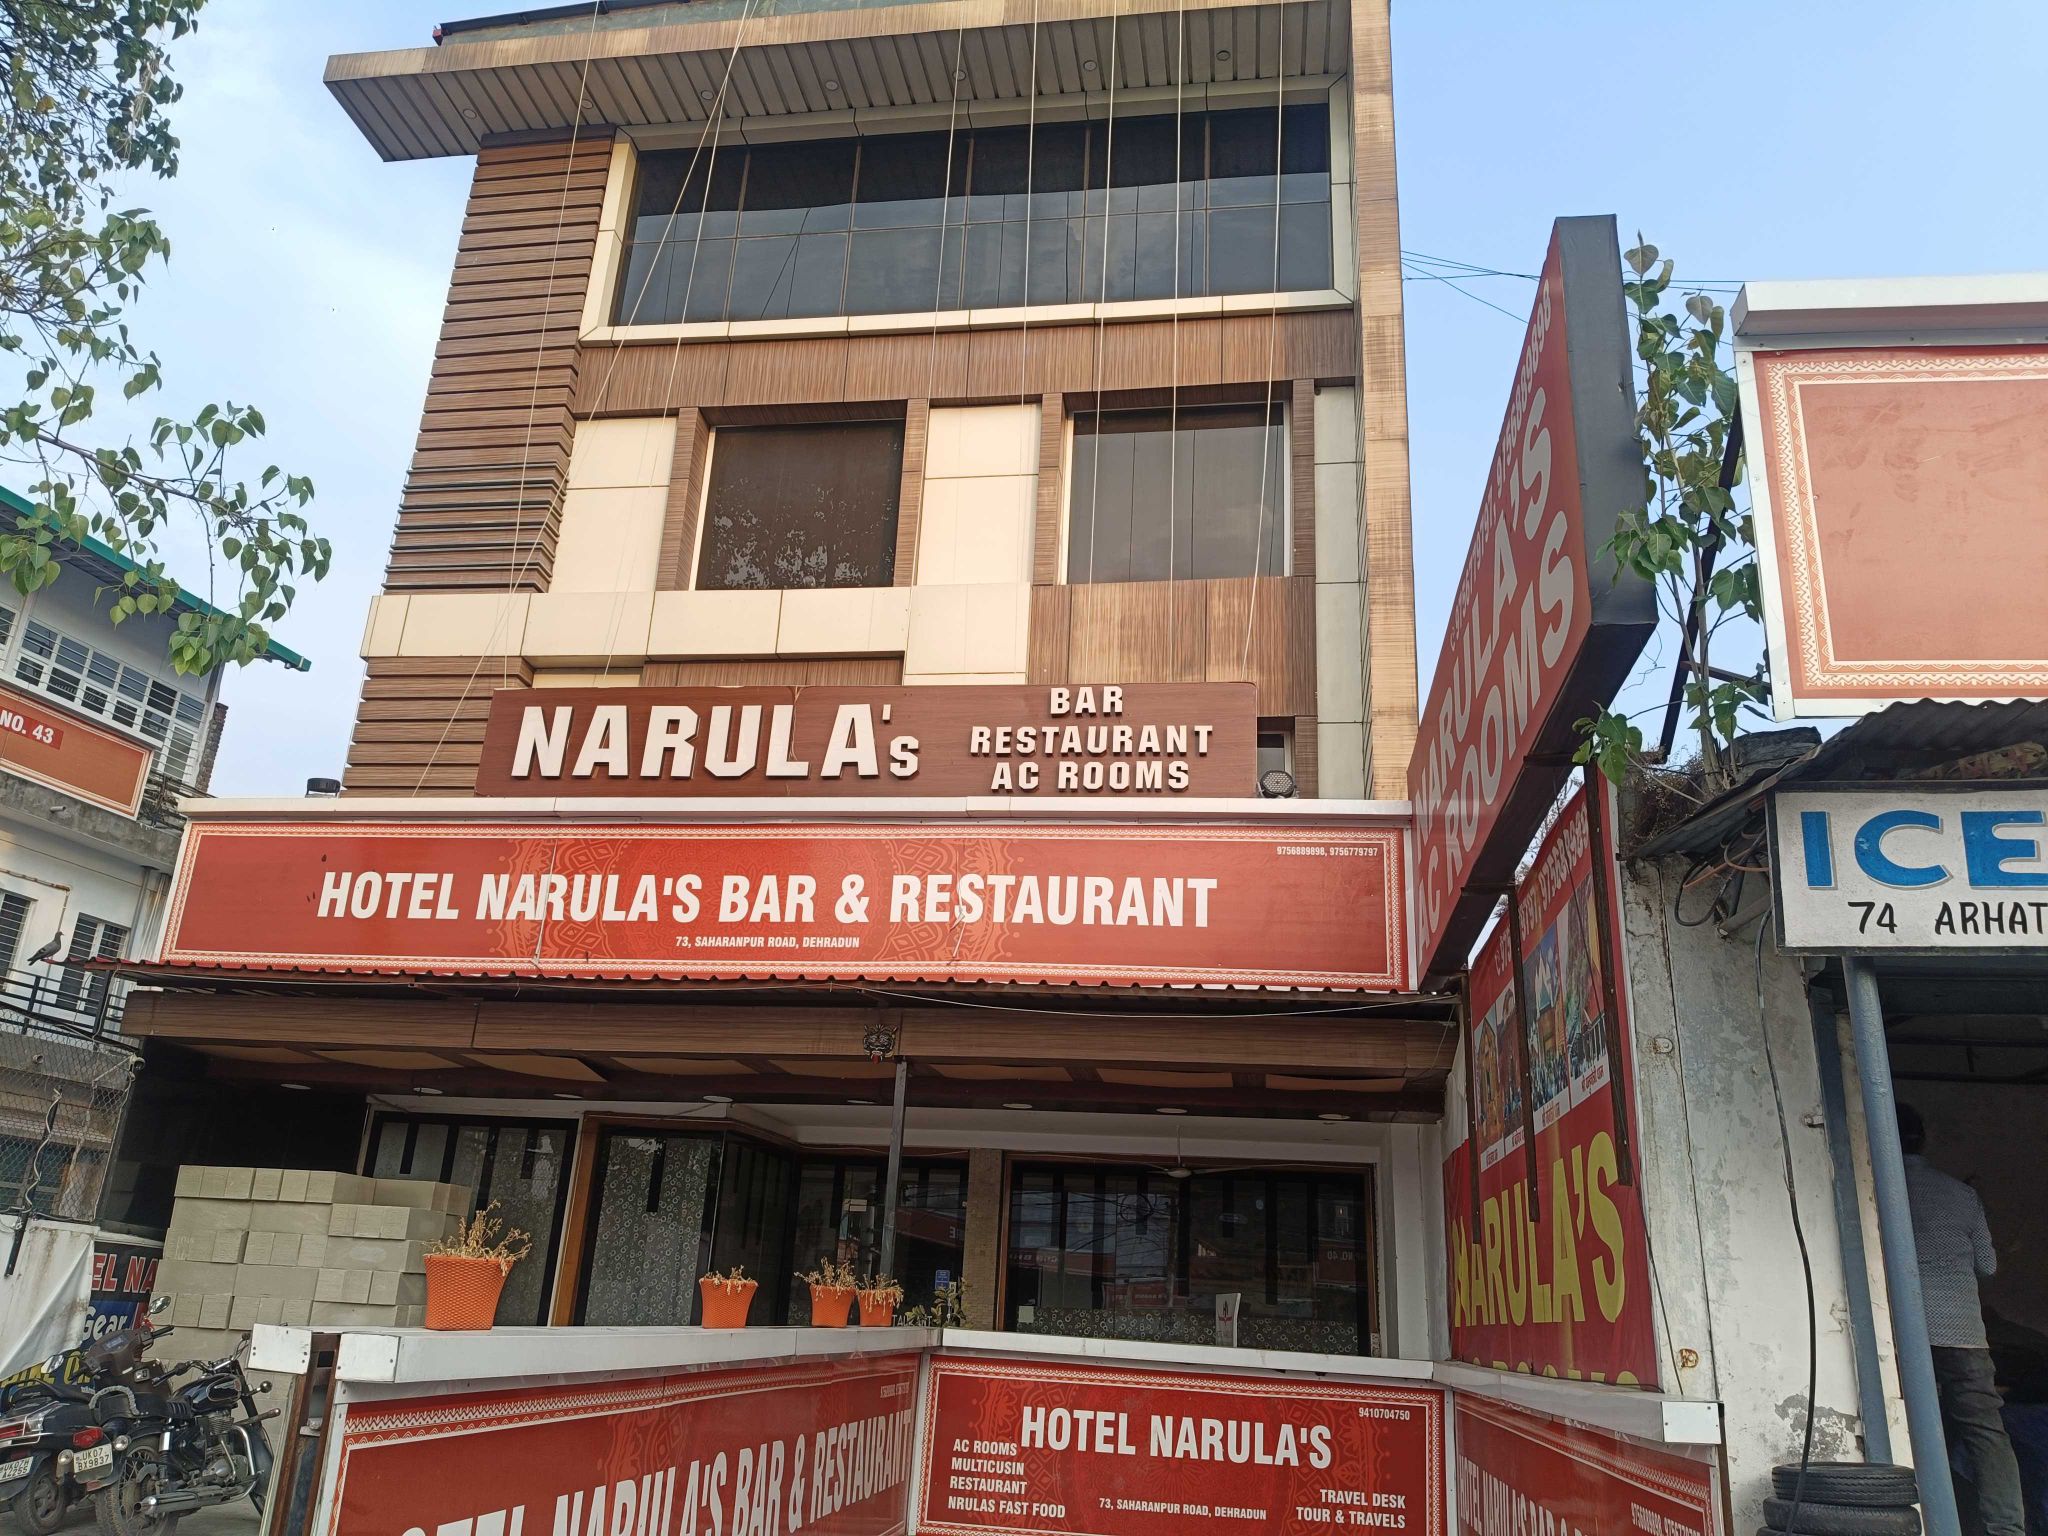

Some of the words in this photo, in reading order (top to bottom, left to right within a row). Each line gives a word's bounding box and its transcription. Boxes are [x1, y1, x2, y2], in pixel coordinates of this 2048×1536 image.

[1415, 387, 1552, 864] NARULA'S
[1050, 686, 1123, 716] BAR
[0, 709, 26, 735] NO.
[32, 724, 54, 744] 43
[970, 725, 1213, 755] RESTAURANT
[1418, 846, 1440, 955] AC
[1445, 510, 1574, 896] ROOMS
[991, 762, 1039, 791] AC
[1058, 760, 1189, 791] ROOMS
[1800, 809, 2048, 890] ICE
[317, 871, 460, 920] HOTEL
[475, 873, 702, 923] NARULA'S
[719, 874, 818, 923] BAR
[834, 873, 870, 924] &
[889, 874, 1218, 927] RESTAURANT
[1847, 901, 1898, 935] 74
[675, 936, 692, 949] 73,
[694, 936, 765, 948] SAHARANPUR
[767, 937, 799, 949] ROAD,
[802, 936, 860, 948] DEHRADUN
[1453, 1131, 1626, 1328] NARULA'S
[1358, 1406, 1411, 1421] 9410704750
[952, 1438, 970, 1452] AC
[973, 1440, 1018, 1456] ROOMS
[1021, 1405, 1137, 1456] HOTEL
[1149, 1414, 1332, 1470] NARULA'S
[732, 1439, 785, 1536] BAR
[809, 1408, 912, 1524] RESTAURANT
[951, 1457, 1025, 1476] MULTICUSIN
[950, 1475, 1028, 1495] RESTAURANT
[1320, 1488, 1370, 1507] TRAVEL
[1372, 1492, 1406, 1509] DESK
[948, 1496, 996, 1513] NRULAS
[999, 1499, 1029, 1516] FAST
[1032, 1502, 1066, 1518] FOOD
[1099, 1497, 1114, 1511] 73,
[1116, 1498, 1181, 1515] SAHARANPUR
[1183, 1502, 1212, 1518] ROAD,
[1215, 1505, 1267, 1521] DEHRADUN
[1296, 1506, 1332, 1522] TOUR
[1334, 1510, 1345, 1524] &
[1349, 1511, 1406, 1529] TRAVELS
